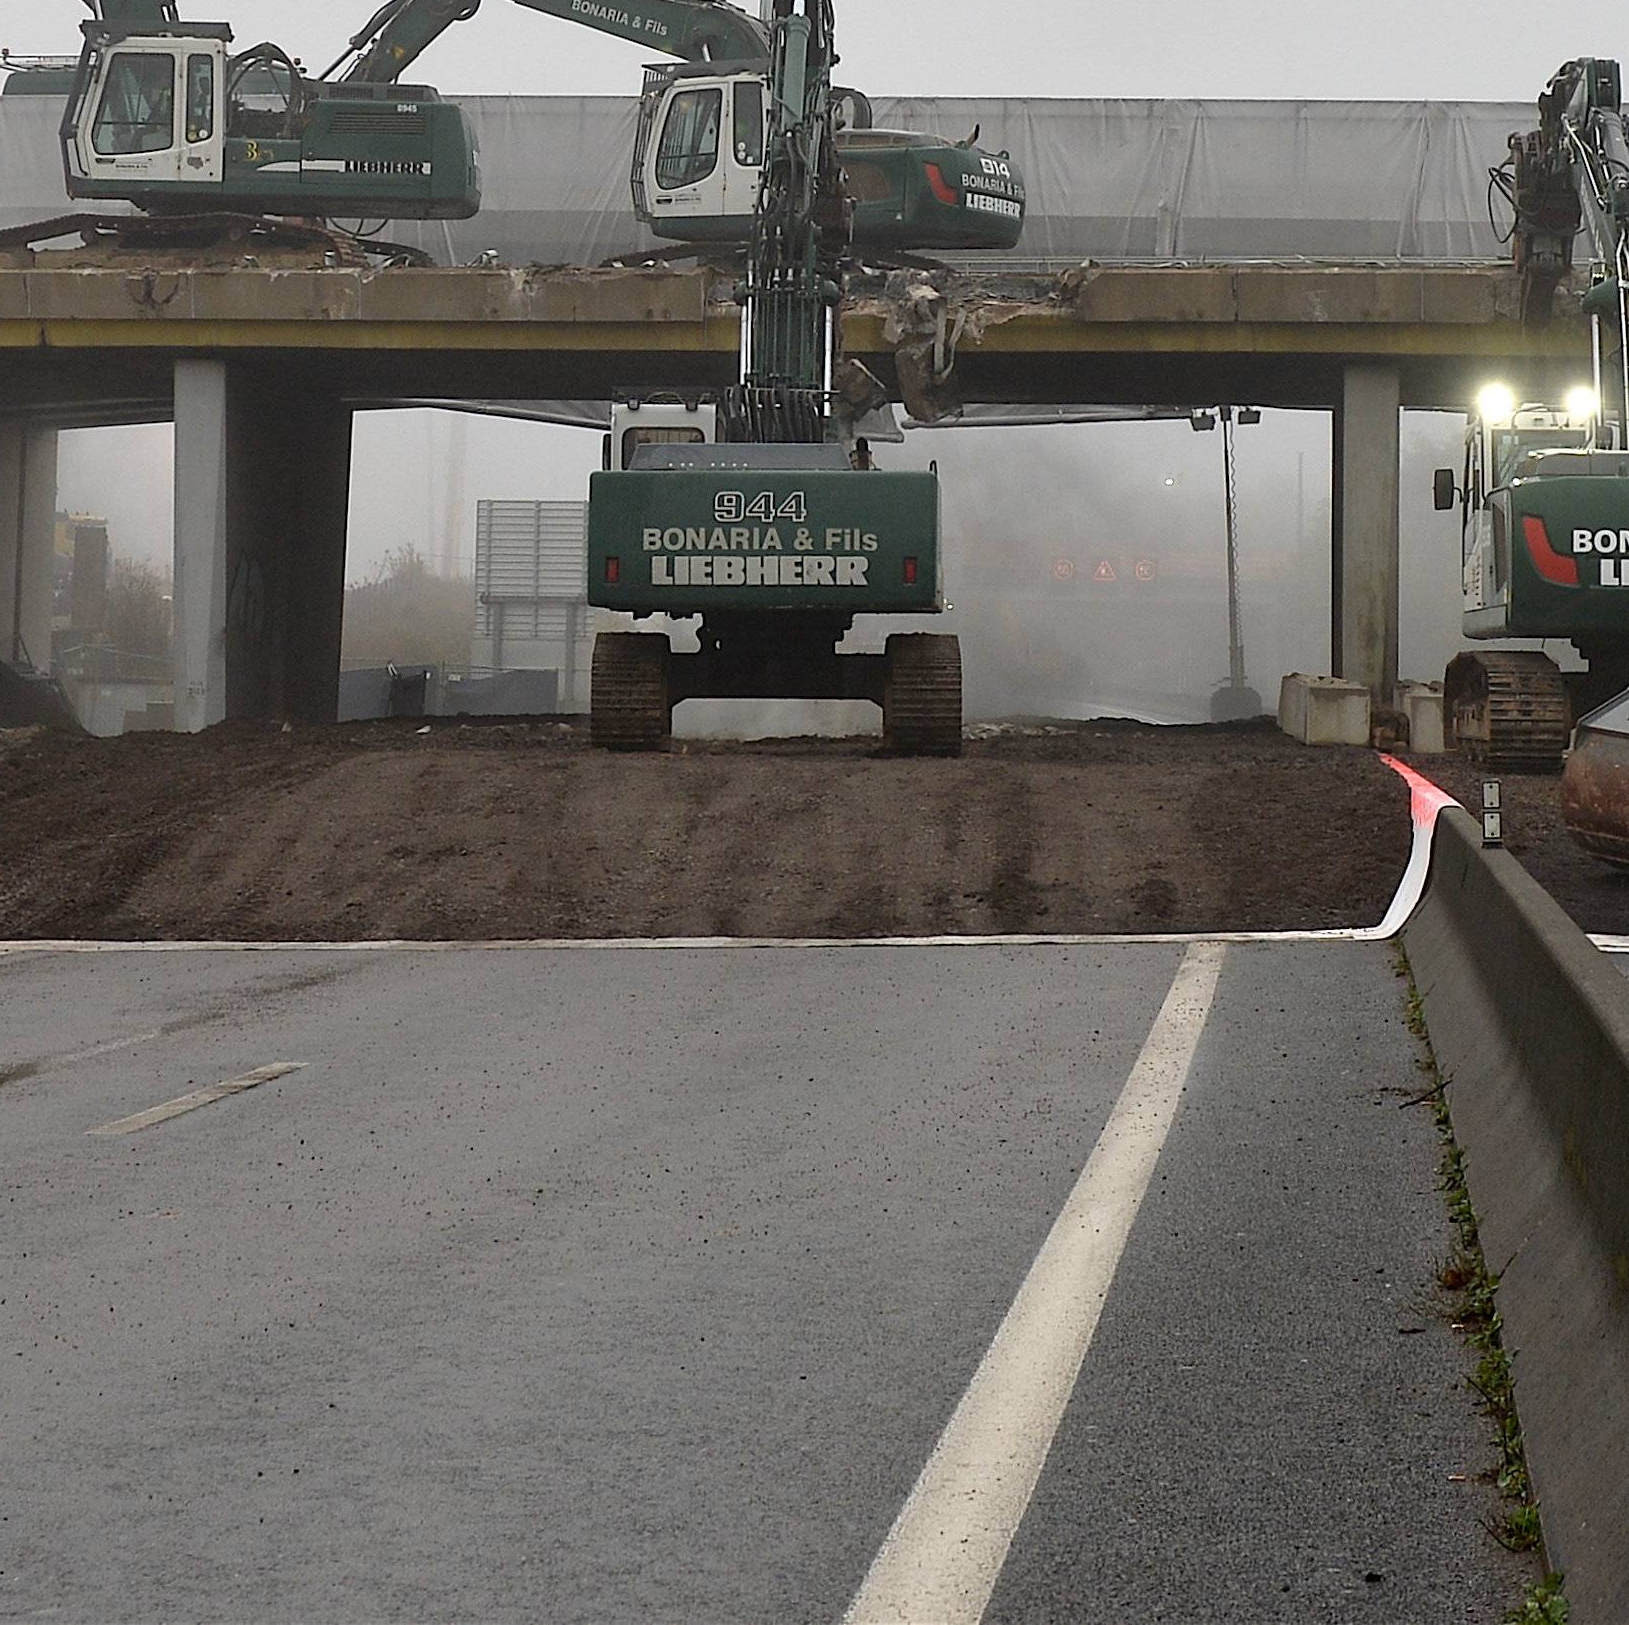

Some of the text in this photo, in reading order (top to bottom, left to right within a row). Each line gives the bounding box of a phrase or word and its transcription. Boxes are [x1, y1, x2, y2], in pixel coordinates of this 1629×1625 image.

[632, 15, 641, 29] &
[644, 19, 669, 36] Fils
[346, 160, 424, 174] LIEBHERR
[962, 173, 1006, 194] BONARIA
[966, 192, 1021, 219] LIEBHERR
[715, 491, 807, 523] 944
[642, 527, 878, 552] BONARIA & Fils
[651, 556, 869, 585] LIEBHERR
